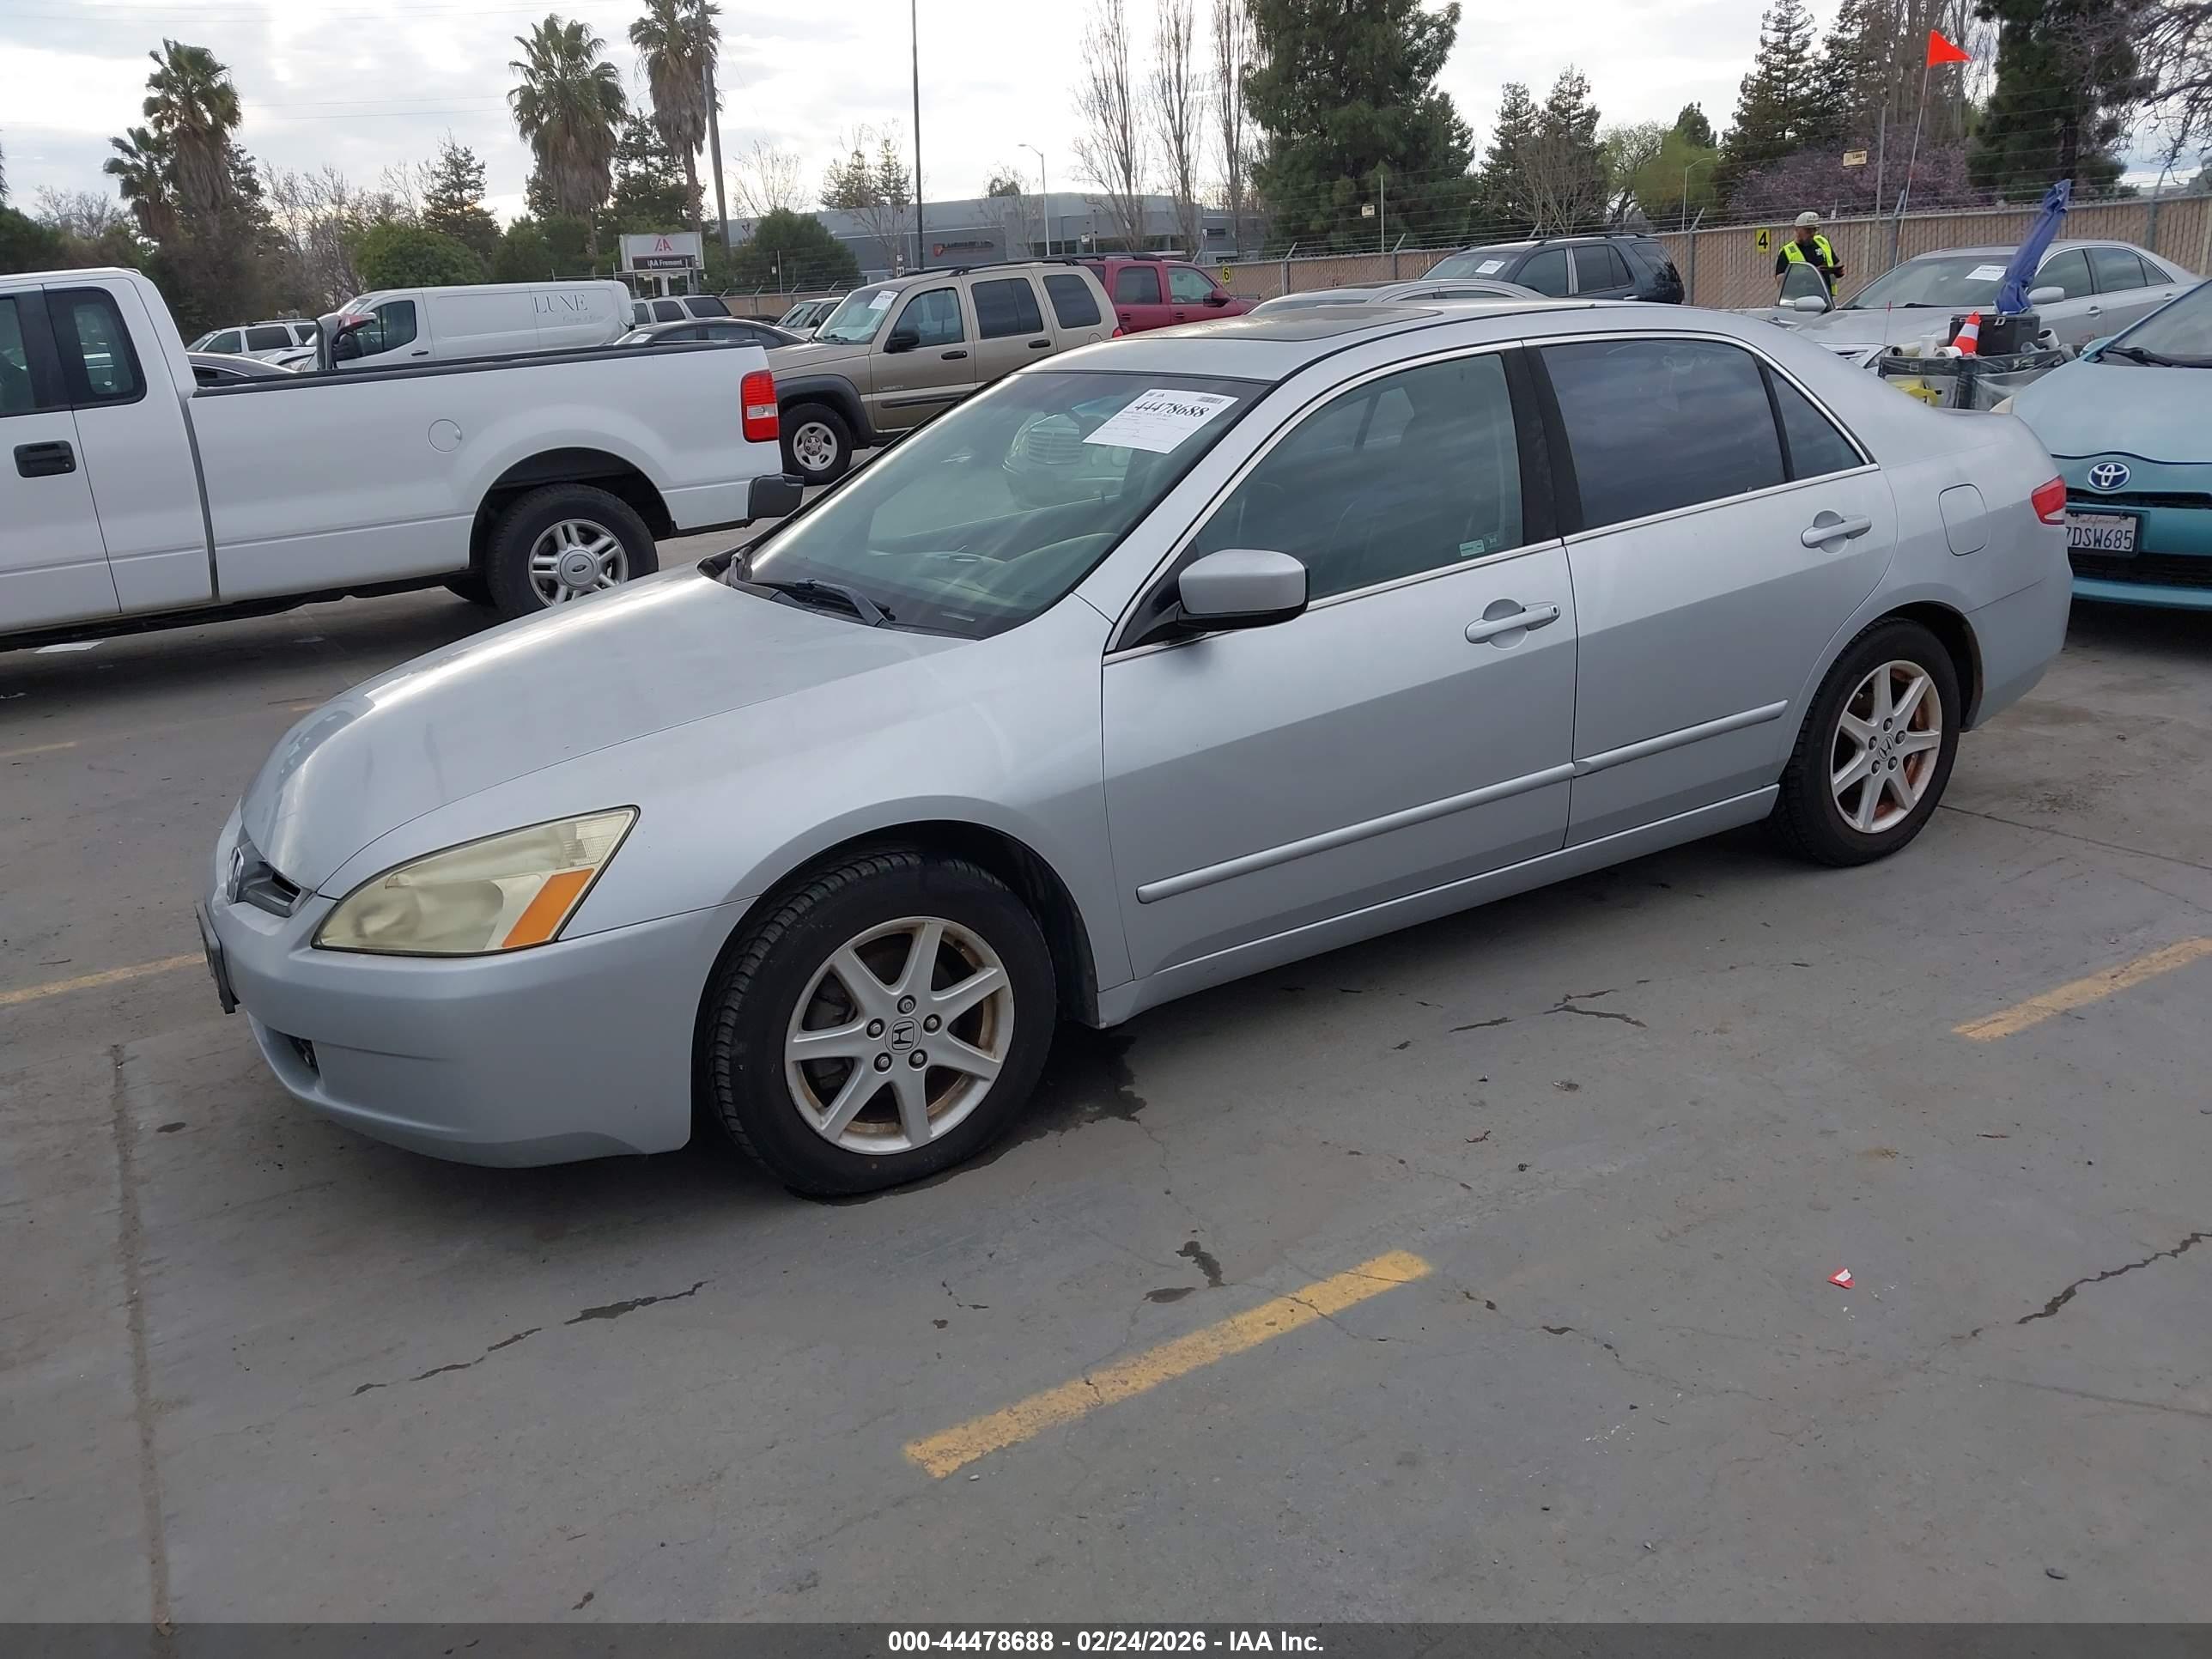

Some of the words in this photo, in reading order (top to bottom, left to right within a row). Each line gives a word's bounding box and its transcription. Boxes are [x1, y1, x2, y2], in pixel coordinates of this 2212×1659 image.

[1758, 231, 1768, 249] 4
[1224, 267, 1230, 281] 6
[533, 294, 588, 314] LUXE
[1133, 401, 1210, 418] 44478688
